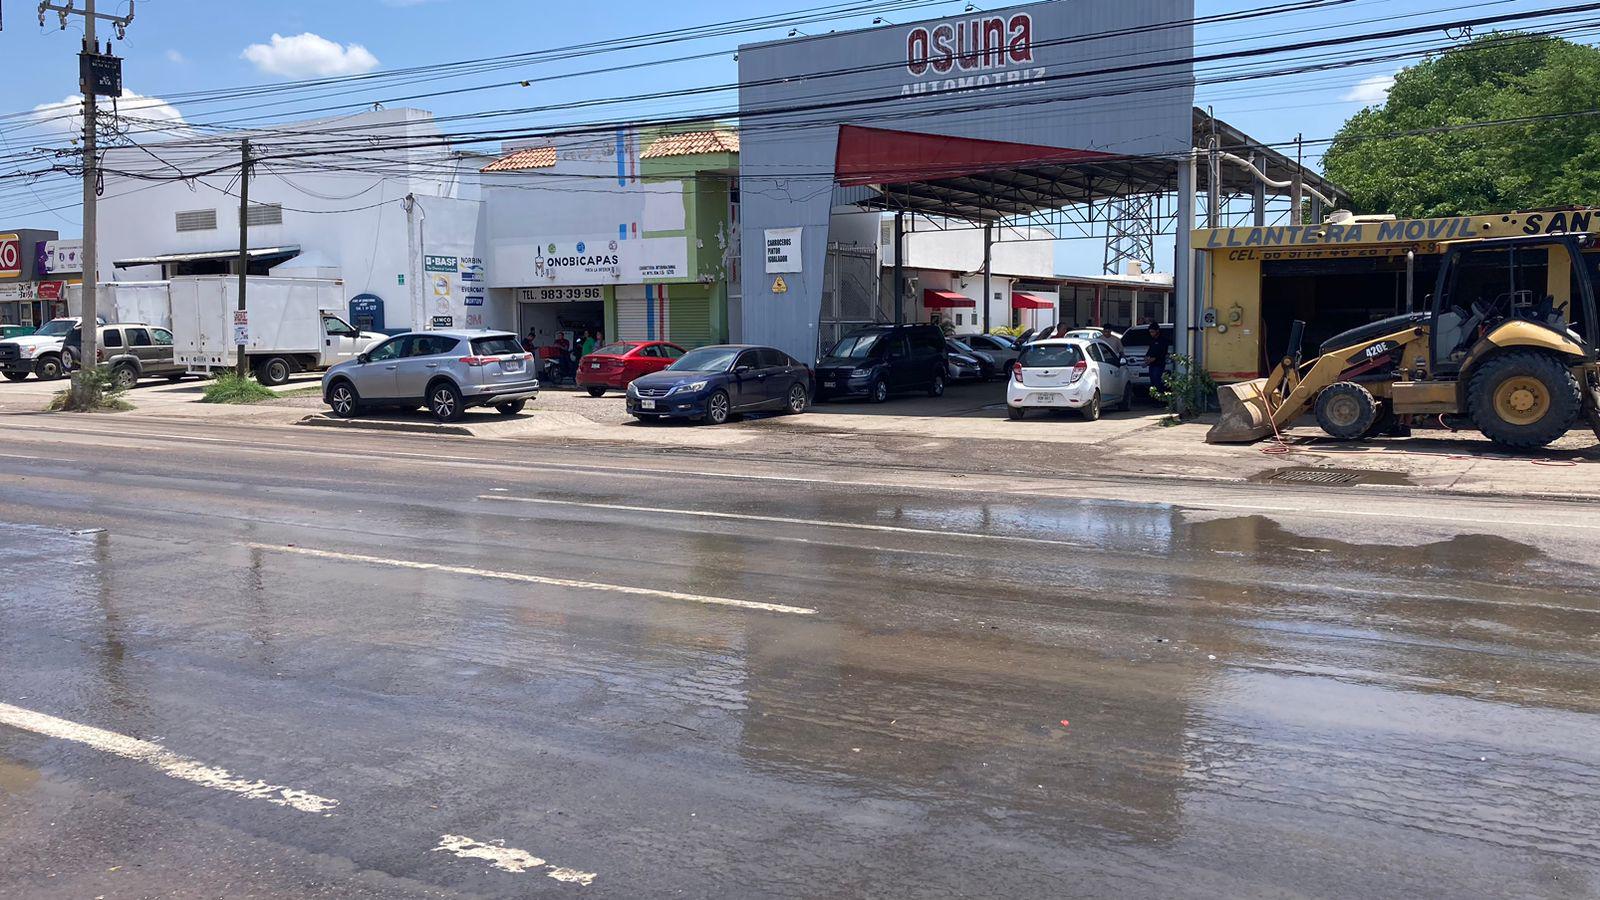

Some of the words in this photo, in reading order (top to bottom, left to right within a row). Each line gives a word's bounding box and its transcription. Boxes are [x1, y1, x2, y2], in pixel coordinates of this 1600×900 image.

[907, 12, 1034, 76] osuna
[900, 67, 1046, 100] AUTOMOTRIZ
[1522, 210, 1600, 235] SAN
[1207, 224, 1362, 248] LLANTERA
[1377, 217, 1477, 242] MOVIL
[767, 238, 792, 247] CARROCEROS
[767, 247, 781, 255] PINTOR
[1228, 250, 1259, 261] CEL.
[434, 257, 457, 267] BASF
[522, 289, 537, 300] TEL.
[1365, 341, 1389, 357] 420E
